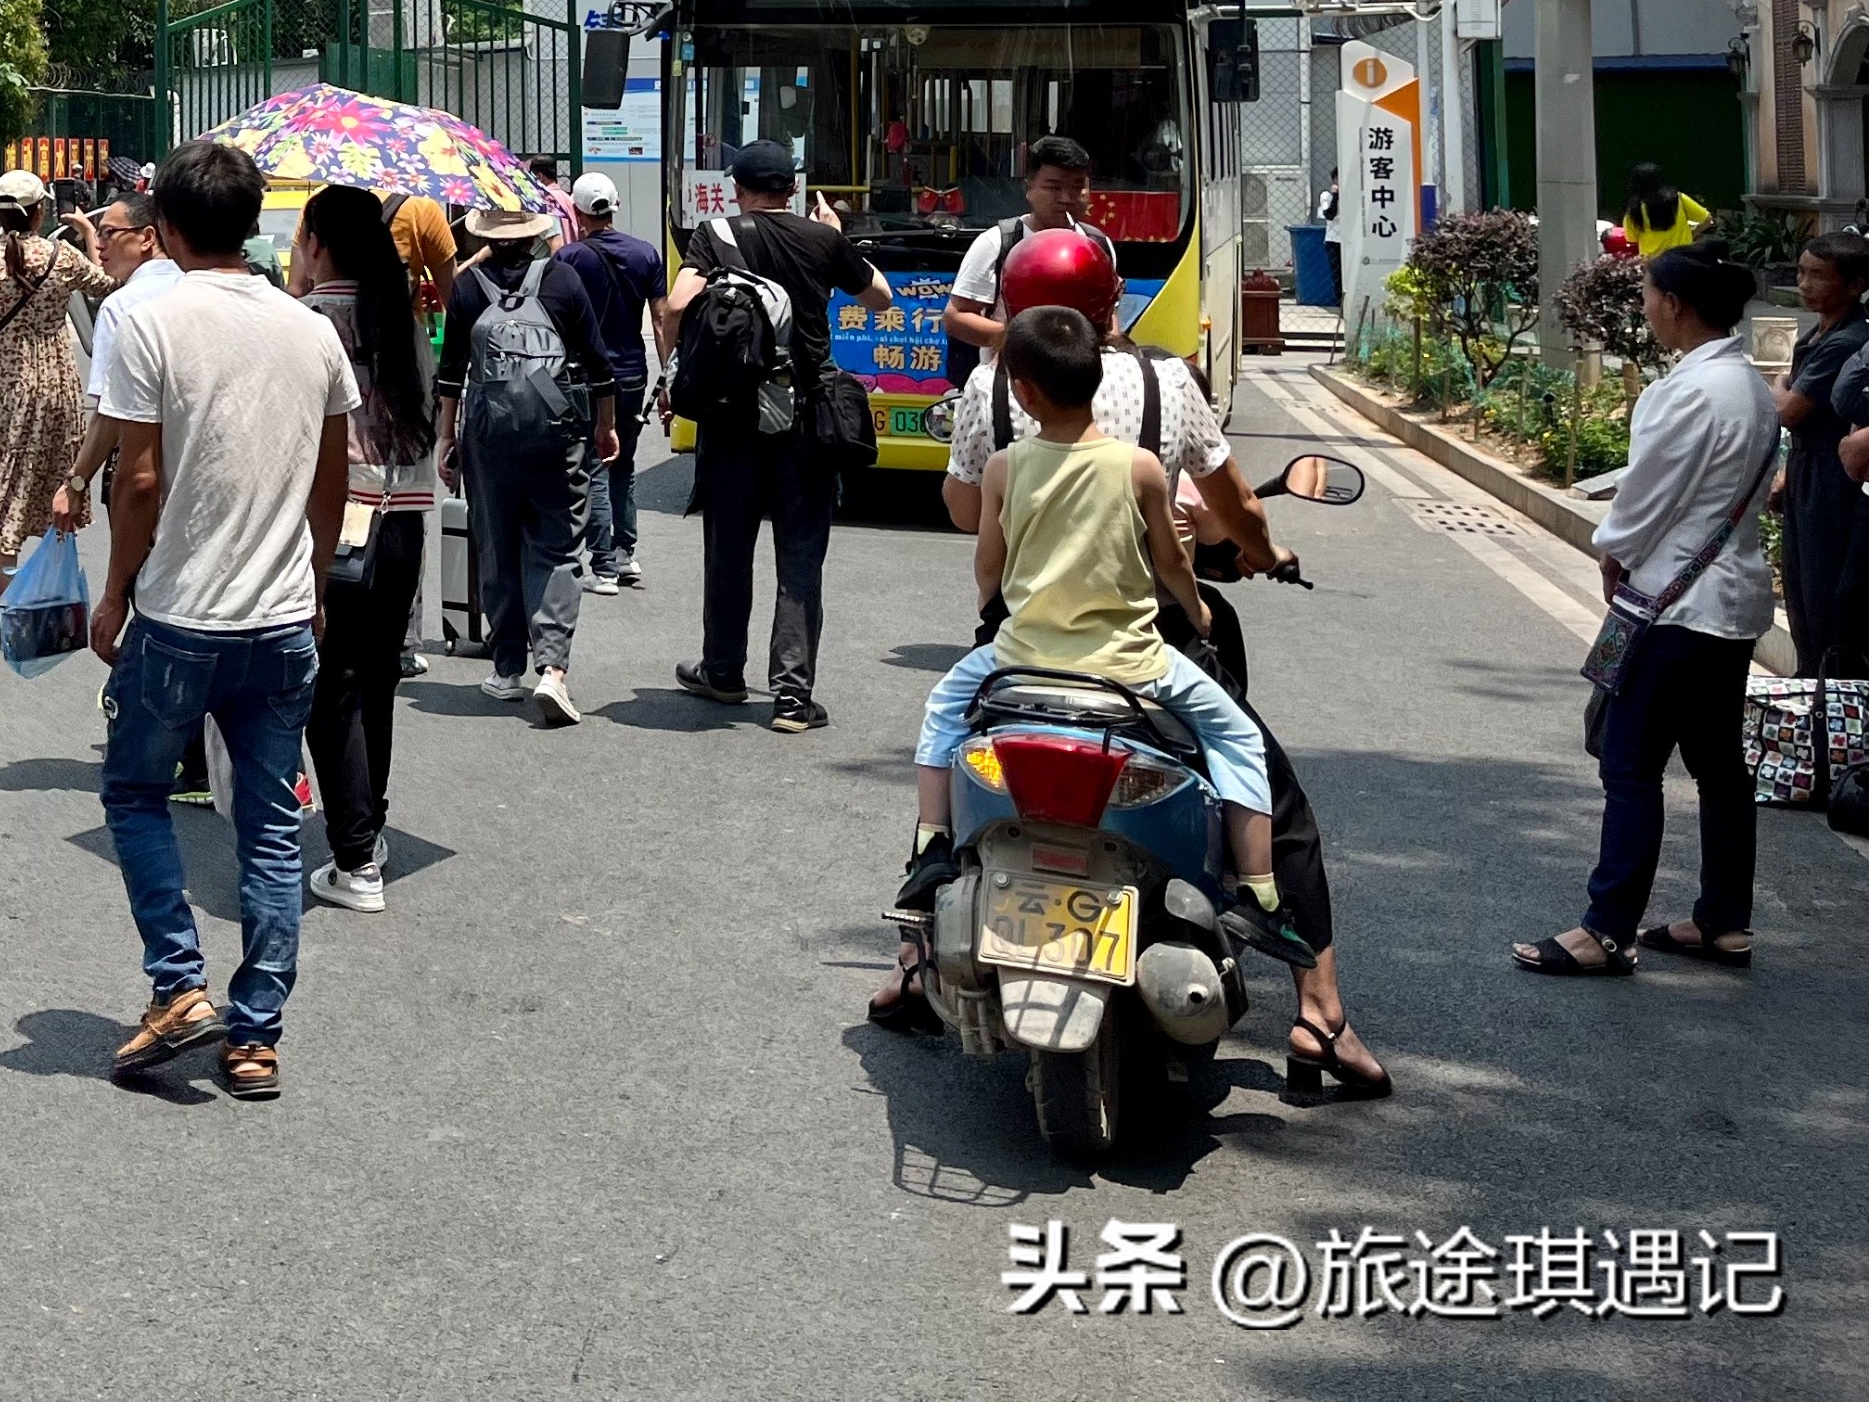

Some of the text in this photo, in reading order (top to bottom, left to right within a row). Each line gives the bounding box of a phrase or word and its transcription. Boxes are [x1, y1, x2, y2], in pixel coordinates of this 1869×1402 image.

[1368, 127, 1397, 238] 游客中心
[896, 283, 952, 297] WOW
[873, 344, 943, 372] 畅游
